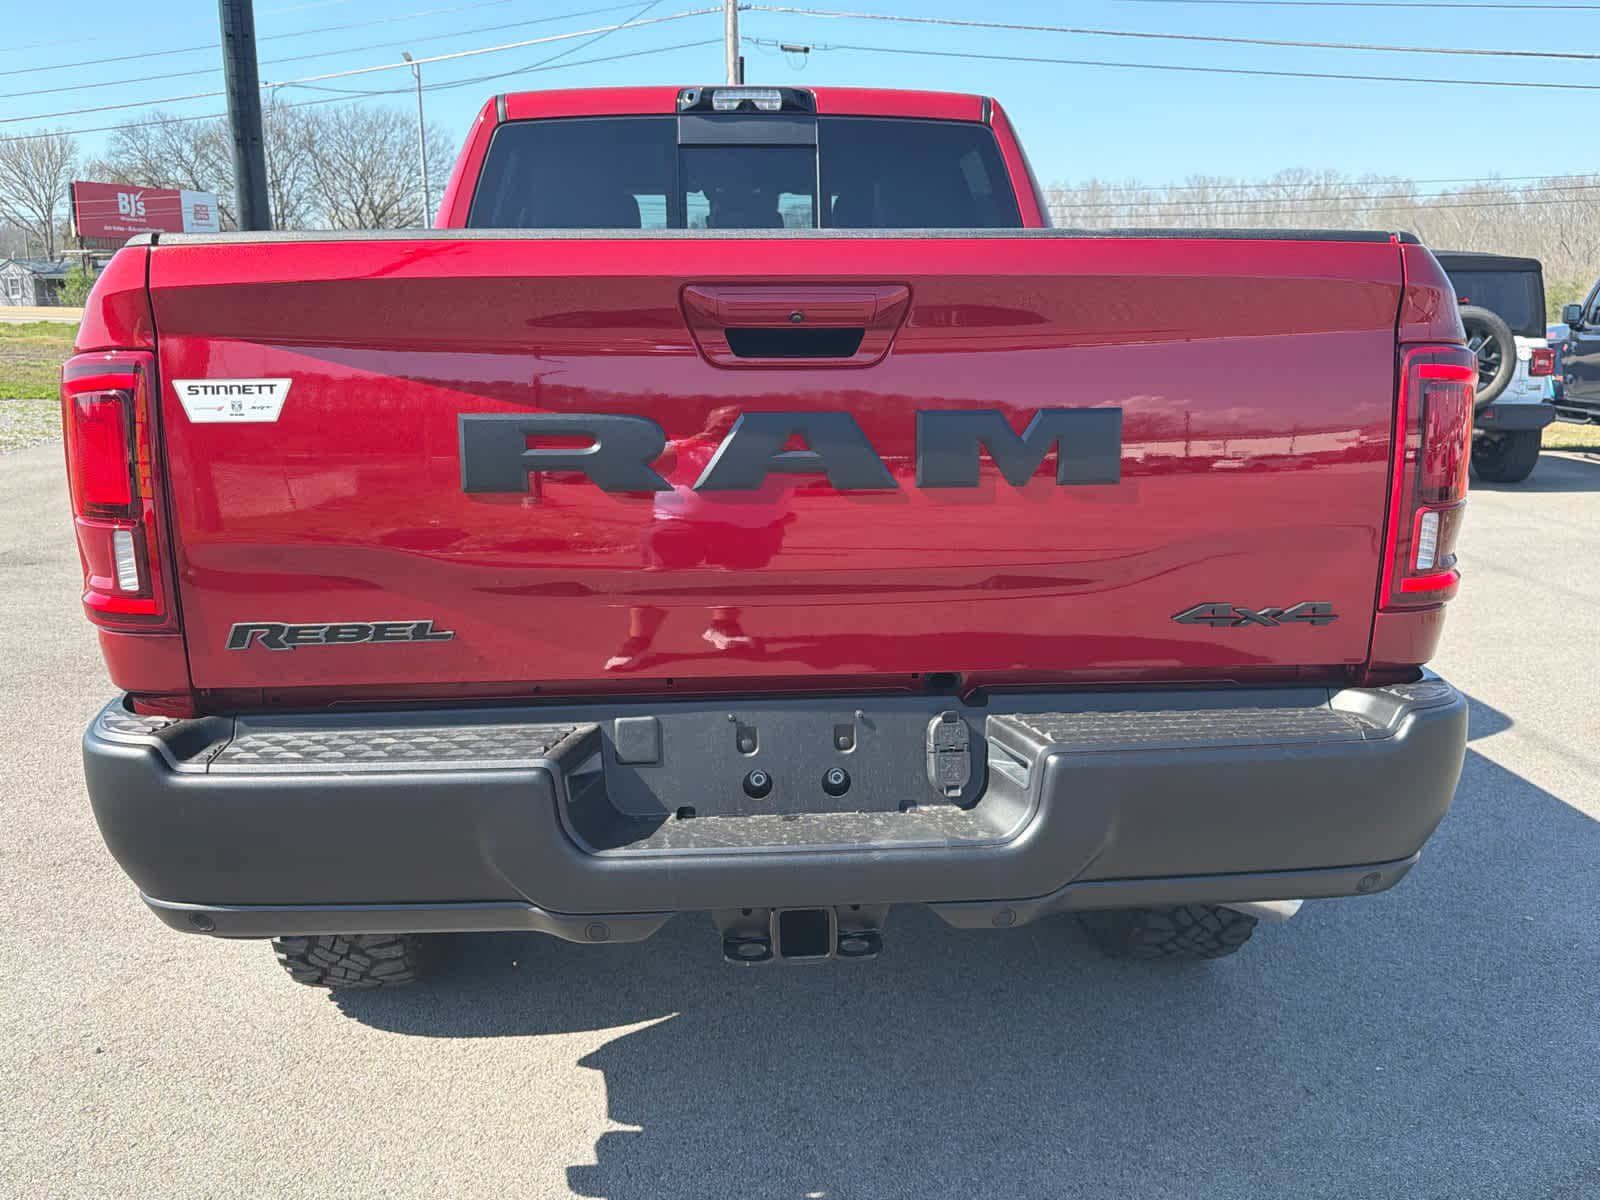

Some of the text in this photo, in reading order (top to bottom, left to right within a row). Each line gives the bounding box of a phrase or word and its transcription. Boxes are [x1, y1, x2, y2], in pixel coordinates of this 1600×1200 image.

[117, 191, 146, 217] BJ's
[458, 407, 1123, 493] RAM
[1170, 601, 1339, 627] 4x4
[225, 620, 456, 651] REBEL
